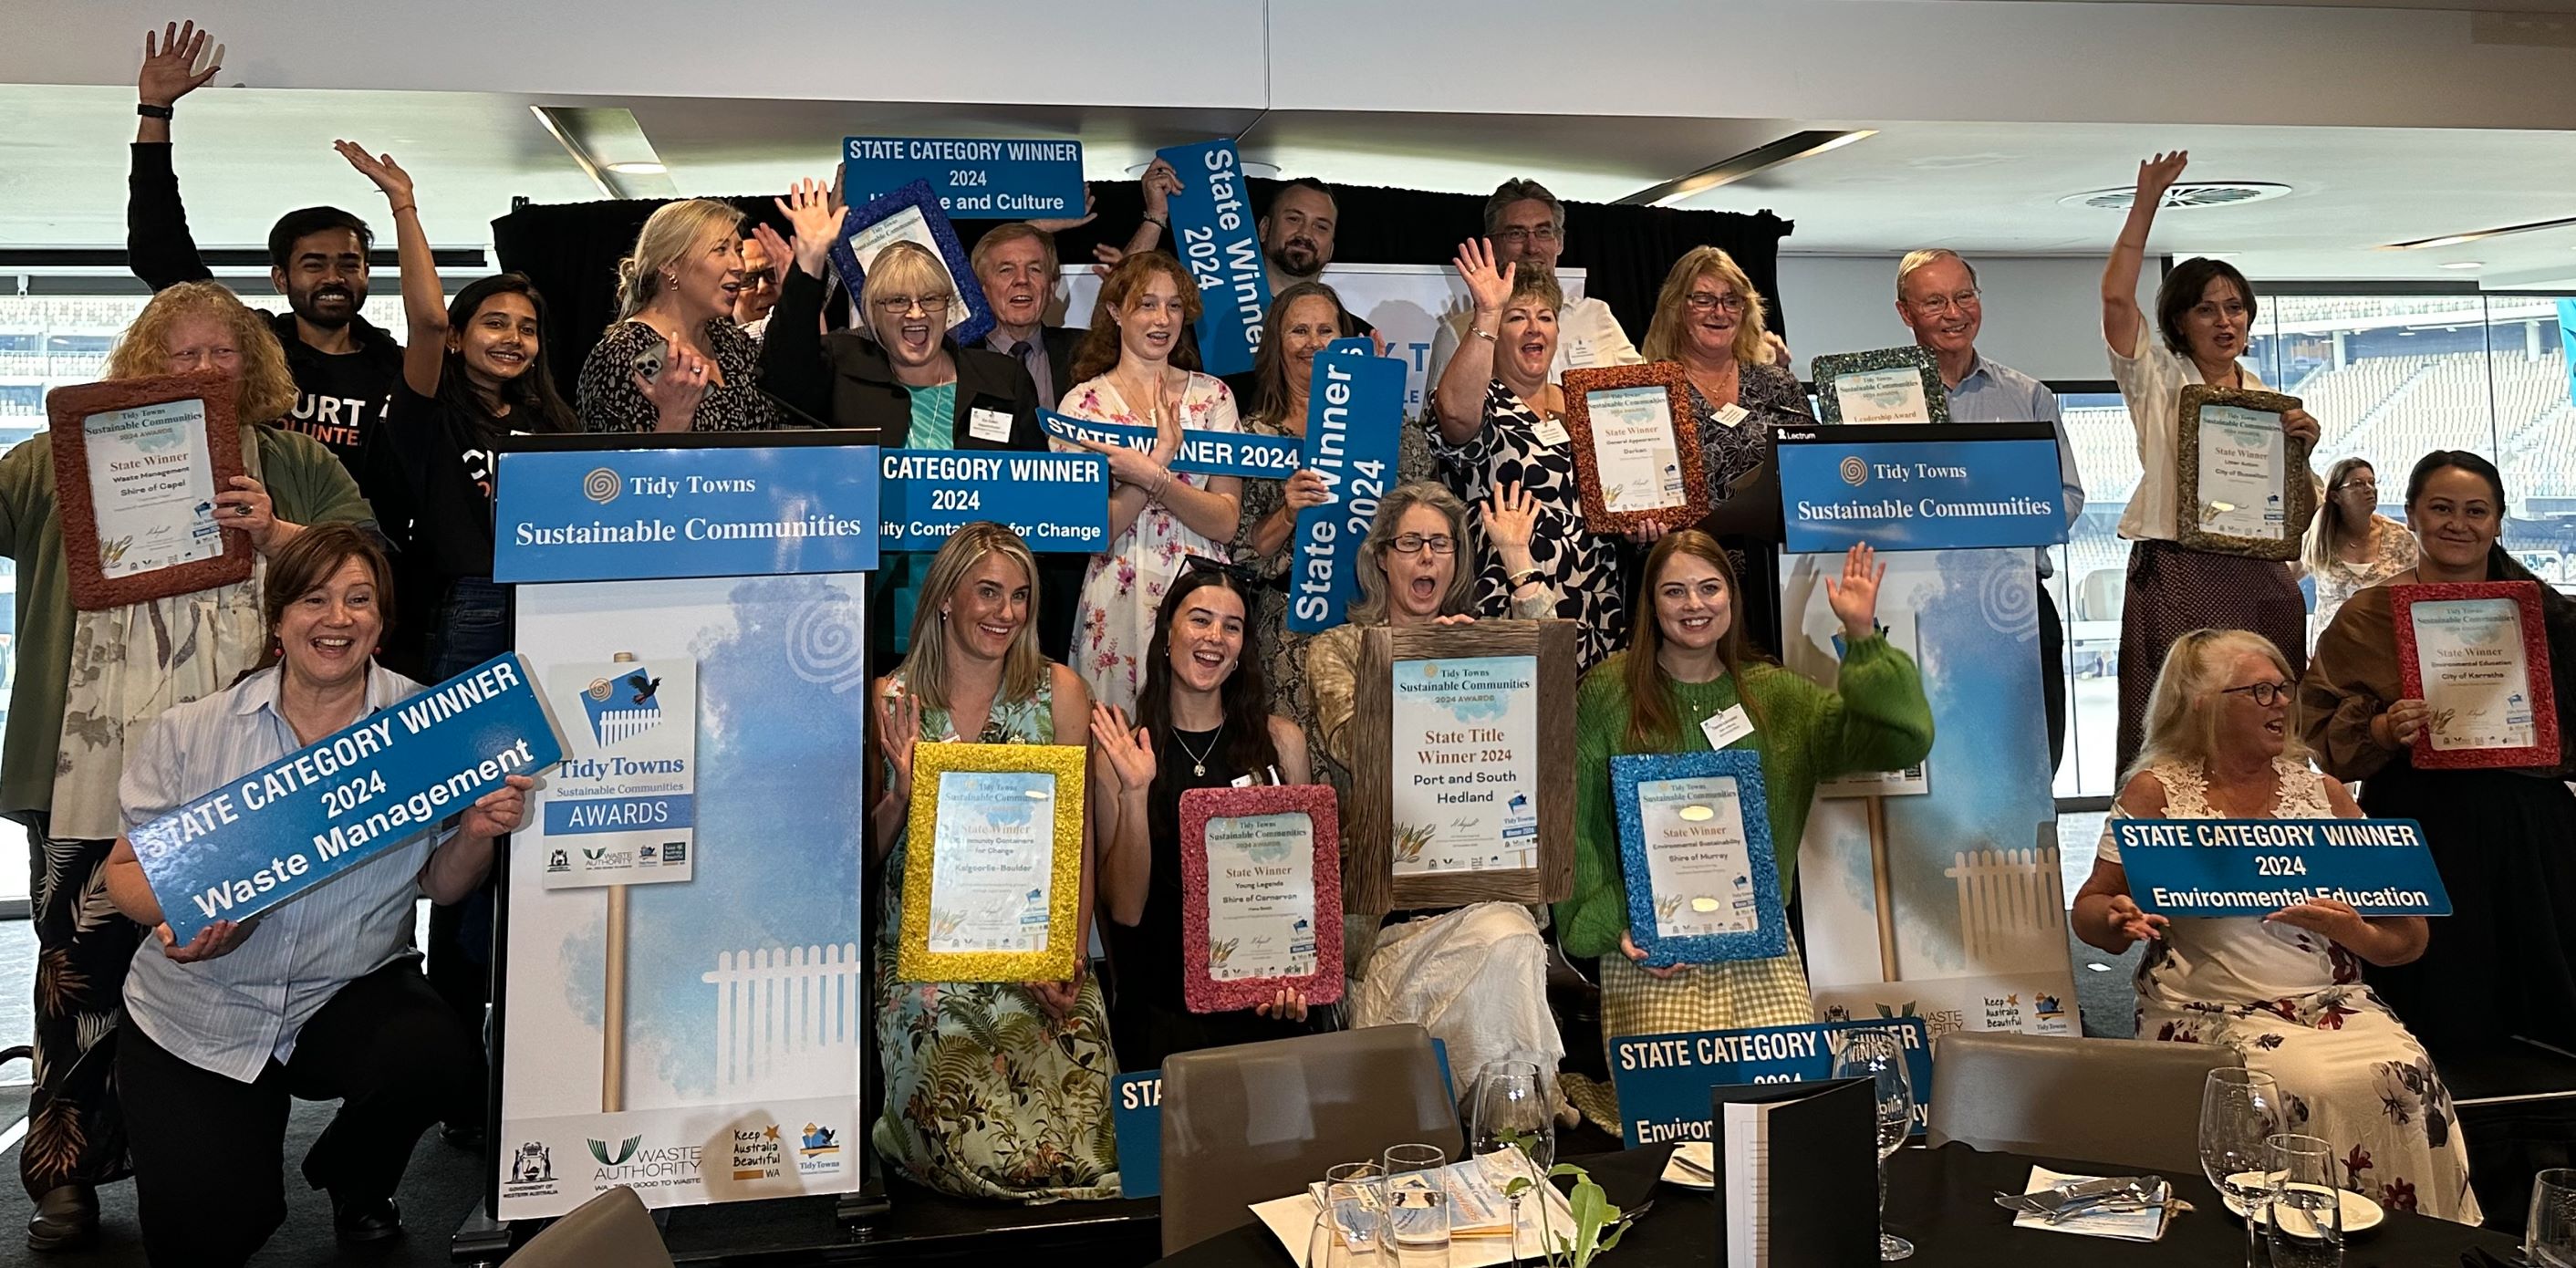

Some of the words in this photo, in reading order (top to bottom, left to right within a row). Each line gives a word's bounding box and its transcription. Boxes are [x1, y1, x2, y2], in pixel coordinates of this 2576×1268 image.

[849, 140, 904, 160] STATE
[909, 140, 1003, 161] CATEGORY
[1007, 142, 1077, 162] WINNER
[949, 170, 987, 187] 2024
[1204, 148, 1242, 232] State
[957, 193, 992, 210] and
[997, 193, 1065, 211] Culture
[1183, 225, 1224, 291] 2024
[86, 421, 140, 435] Sustainable
[142, 412, 203, 429] Communities
[1893, 411, 1916, 419] Award
[1310, 363, 1353, 505] Winner
[1605, 428, 1626, 437] State
[1627, 426, 1658, 435] Winner
[1786, 431, 1816, 441] Lectrum
[1127, 435, 1233, 465] WNER
[1240, 445, 1301, 470] 2024
[2215, 446, 2237, 456] State
[2237, 449, 2269, 461] Winner
[109, 459, 140, 473] State
[143, 452, 189, 467] Winner
[882, 455, 1003, 481] CATEGORY
[1010, 459, 1100, 483] WINNER
[112, 474, 139, 483] Waste
[140, 465, 190, 480] Management
[1873, 463, 1910, 482] Tidy
[1915, 463, 1968, 479] Towns
[120, 485, 146, 497] Shire
[148, 483, 157, 493] of
[159, 480, 186, 491] Capel
[630, 476, 680, 498] Tidy
[686, 474, 756, 494] Towns
[931, 490, 981, 511] 2024
[1347, 459, 1386, 535] 2024
[1797, 499, 1915, 521] Sustainable
[1918, 495, 2052, 519] Communities
[515, 517, 676, 546] Sustainable
[684, 514, 862, 543] Communities
[1037, 522, 1101, 541] Change
[1295, 520, 1337, 622] State
[2436, 648, 2463, 658] State
[2464, 648, 2503, 657] Winner
[1441, 669, 1459, 680] Tidy
[1463, 668, 1490, 678] Towns
[2441, 672, 2457, 681] City
[2458, 671, 2467, 680] of
[1399, 680, 1459, 692] Sustainable
[1460, 678, 1531, 691] Communities
[1434, 695, 1457, 703] 2024
[1458, 694, 1495, 702] AWARDS
[1425, 729, 1465, 745] State
[1468, 728, 1505, 743] Title
[148, 792, 239, 859] STATE
[240, 716, 394, 811] CATEGORY
[397, 660, 521, 735] WINNER
[1417, 749, 1477, 765] Winner
[1480, 749, 1512, 763] 2024
[1414, 774, 1445, 786] Port
[1448, 773, 1472, 785] and
[1476, 770, 1517, 784] South
[321, 769, 387, 820] 2024
[556, 785, 616, 797] Sustainable
[618, 783, 684, 795] Communities
[1437, 790, 1494, 805] Hedland
[568, 800, 669, 828] AWARDS
[192, 851, 310, 920] Waste
[313, 737, 535, 863] Management
[1663, 826, 1688, 838] State
[1689, 825, 1727, 837] Winner
[2122, 825, 2193, 847] STATE
[2197, 825, 2314, 847] CATEGORY
[2320, 825, 2420, 847] WINNER
[1690, 853, 1699, 861] of
[1700, 852, 1729, 863] Murray
[1226, 868, 1252, 878] State
[1253, 867, 1293, 877] Winner
[2255, 856, 2307, 877] 2024
[1235, 882, 1255, 890] Young
[1256, 880, 1284, 889] Legends
[1222, 896, 1244, 904] Shire
[1245, 894, 1253, 902] of
[2152, 887, 2311, 909] Environmental
[1984, 996, 2005, 1007] Keep
[1986, 1008, 2019, 1017] Australia
[1987, 1017, 2022, 1028] Beautiful
[1618, 1040, 1691, 1072] STATE
[1697, 1030, 1817, 1065] CATEGORY
[1121, 1078, 1163, 1110] STA
[733, 1128, 761, 1140] Keep
[637, 1146, 702, 1163] WASTE
[733, 1142, 778, 1154] Australia
[733, 1152, 781, 1167] Beautiful
[594, 1159, 702, 1181] AUTHORITY
[765, 1169, 781, 1178] WA
